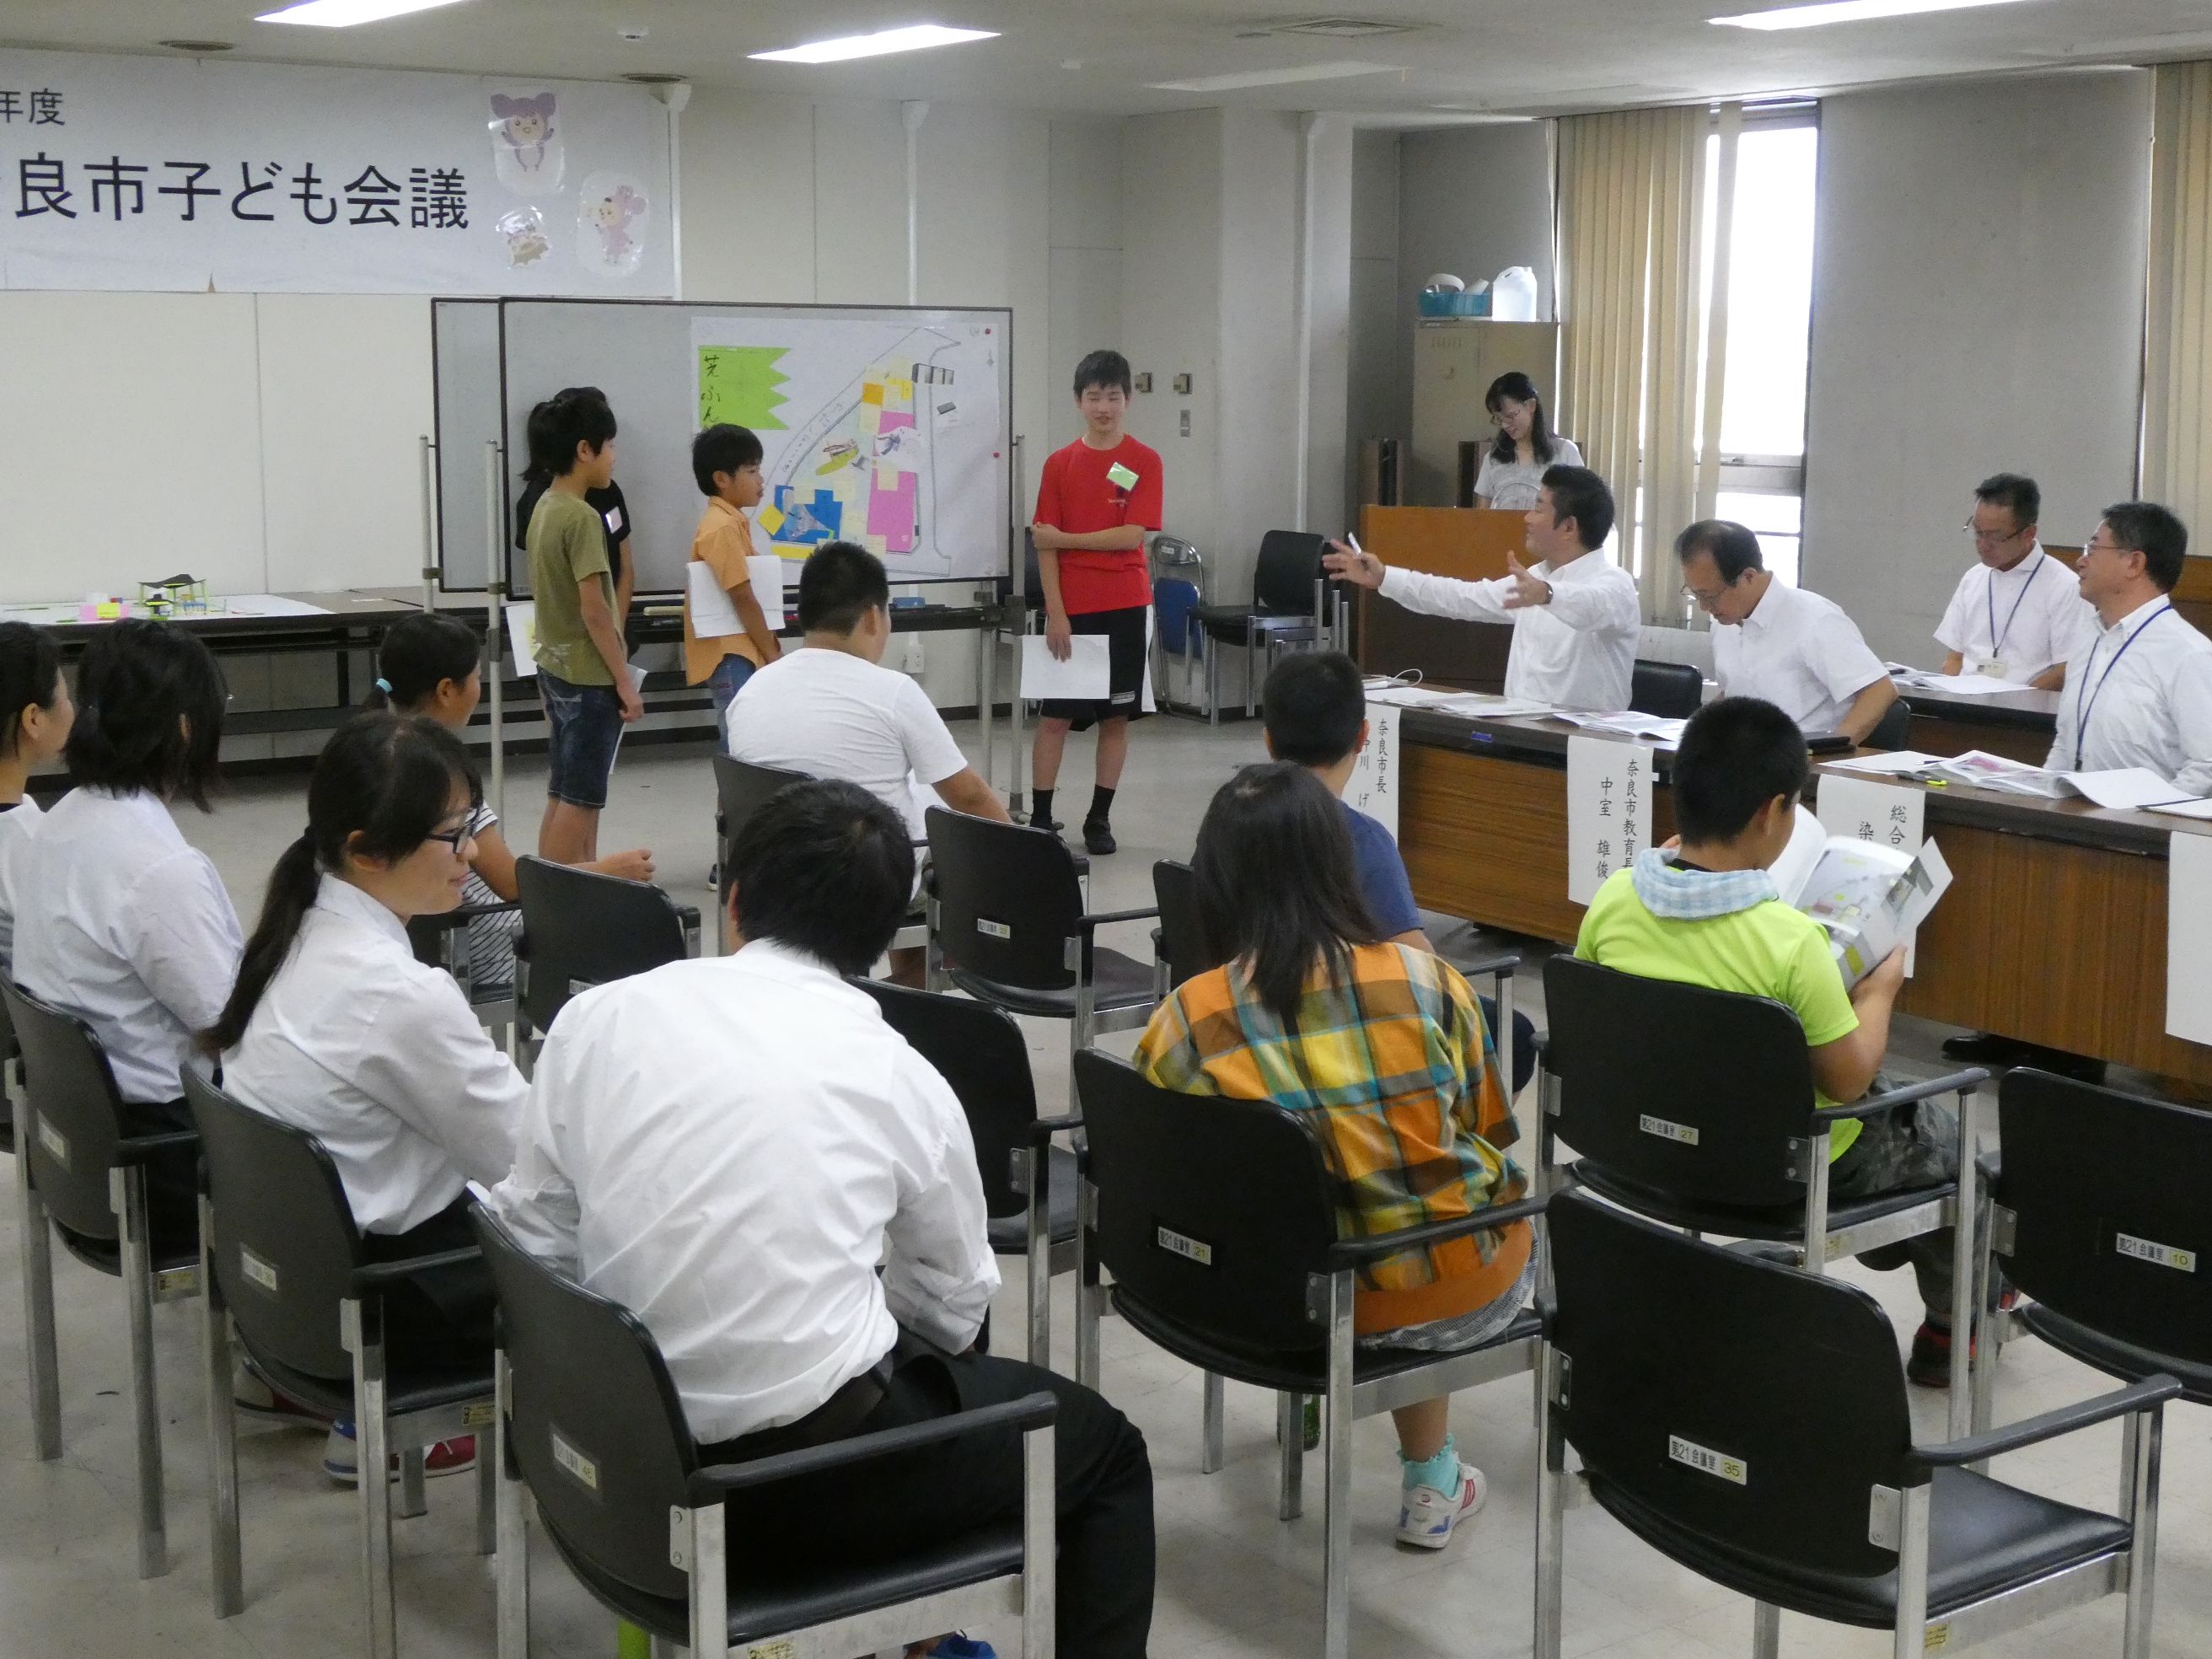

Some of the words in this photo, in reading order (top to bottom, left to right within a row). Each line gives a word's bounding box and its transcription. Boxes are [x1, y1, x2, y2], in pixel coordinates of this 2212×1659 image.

[0, 89, 65, 125] 年度
[15, 152, 470, 229] 良市子ども会議
[1375, 718, 1389, 793] 奈良市長
[1598, 776, 1613, 817] 中室
[1681, 1130, 1694, 1140] 27
[2173, 1254, 2188, 1265] 10
[1723, 1462, 1740, 1478] 35
